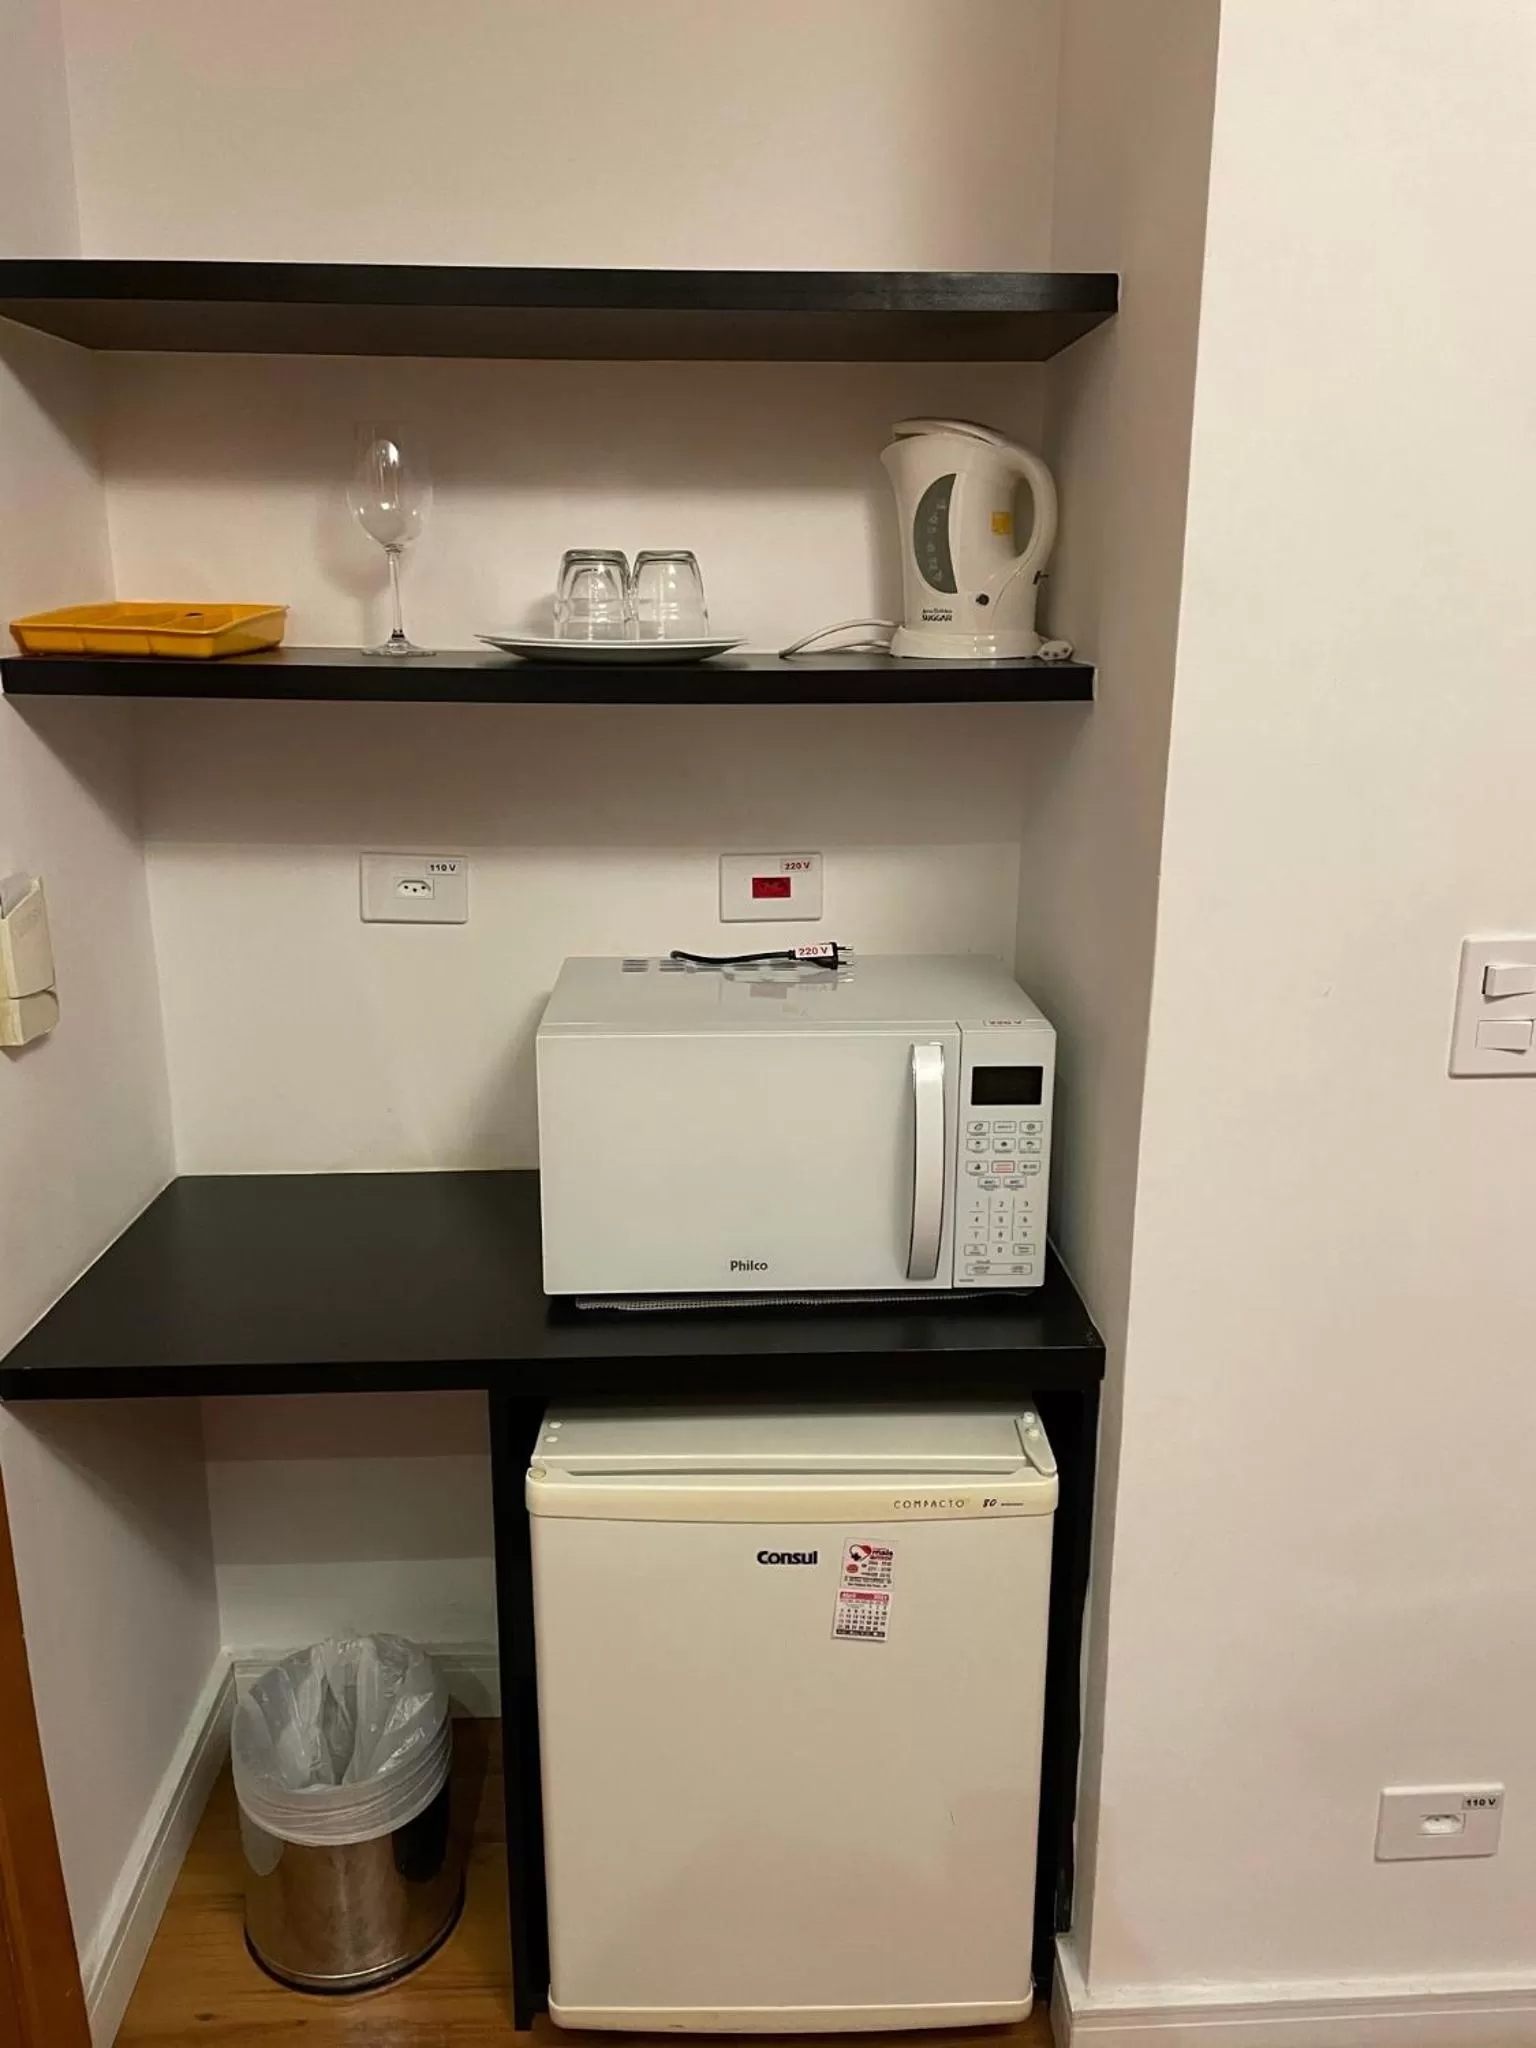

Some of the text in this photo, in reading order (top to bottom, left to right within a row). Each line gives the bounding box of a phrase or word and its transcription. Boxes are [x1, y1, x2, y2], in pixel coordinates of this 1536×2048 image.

[430, 863, 457, 872] 110 V
[784, 861, 811, 870] 220 V
[799, 946, 828, 955] 220 V
[730, 1259, 769, 1271] Philco
[894, 1499, 965, 1509] COMPACTO
[756, 1550, 818, 1565] Consul
[1466, 1798, 1497, 1807] 110 V
